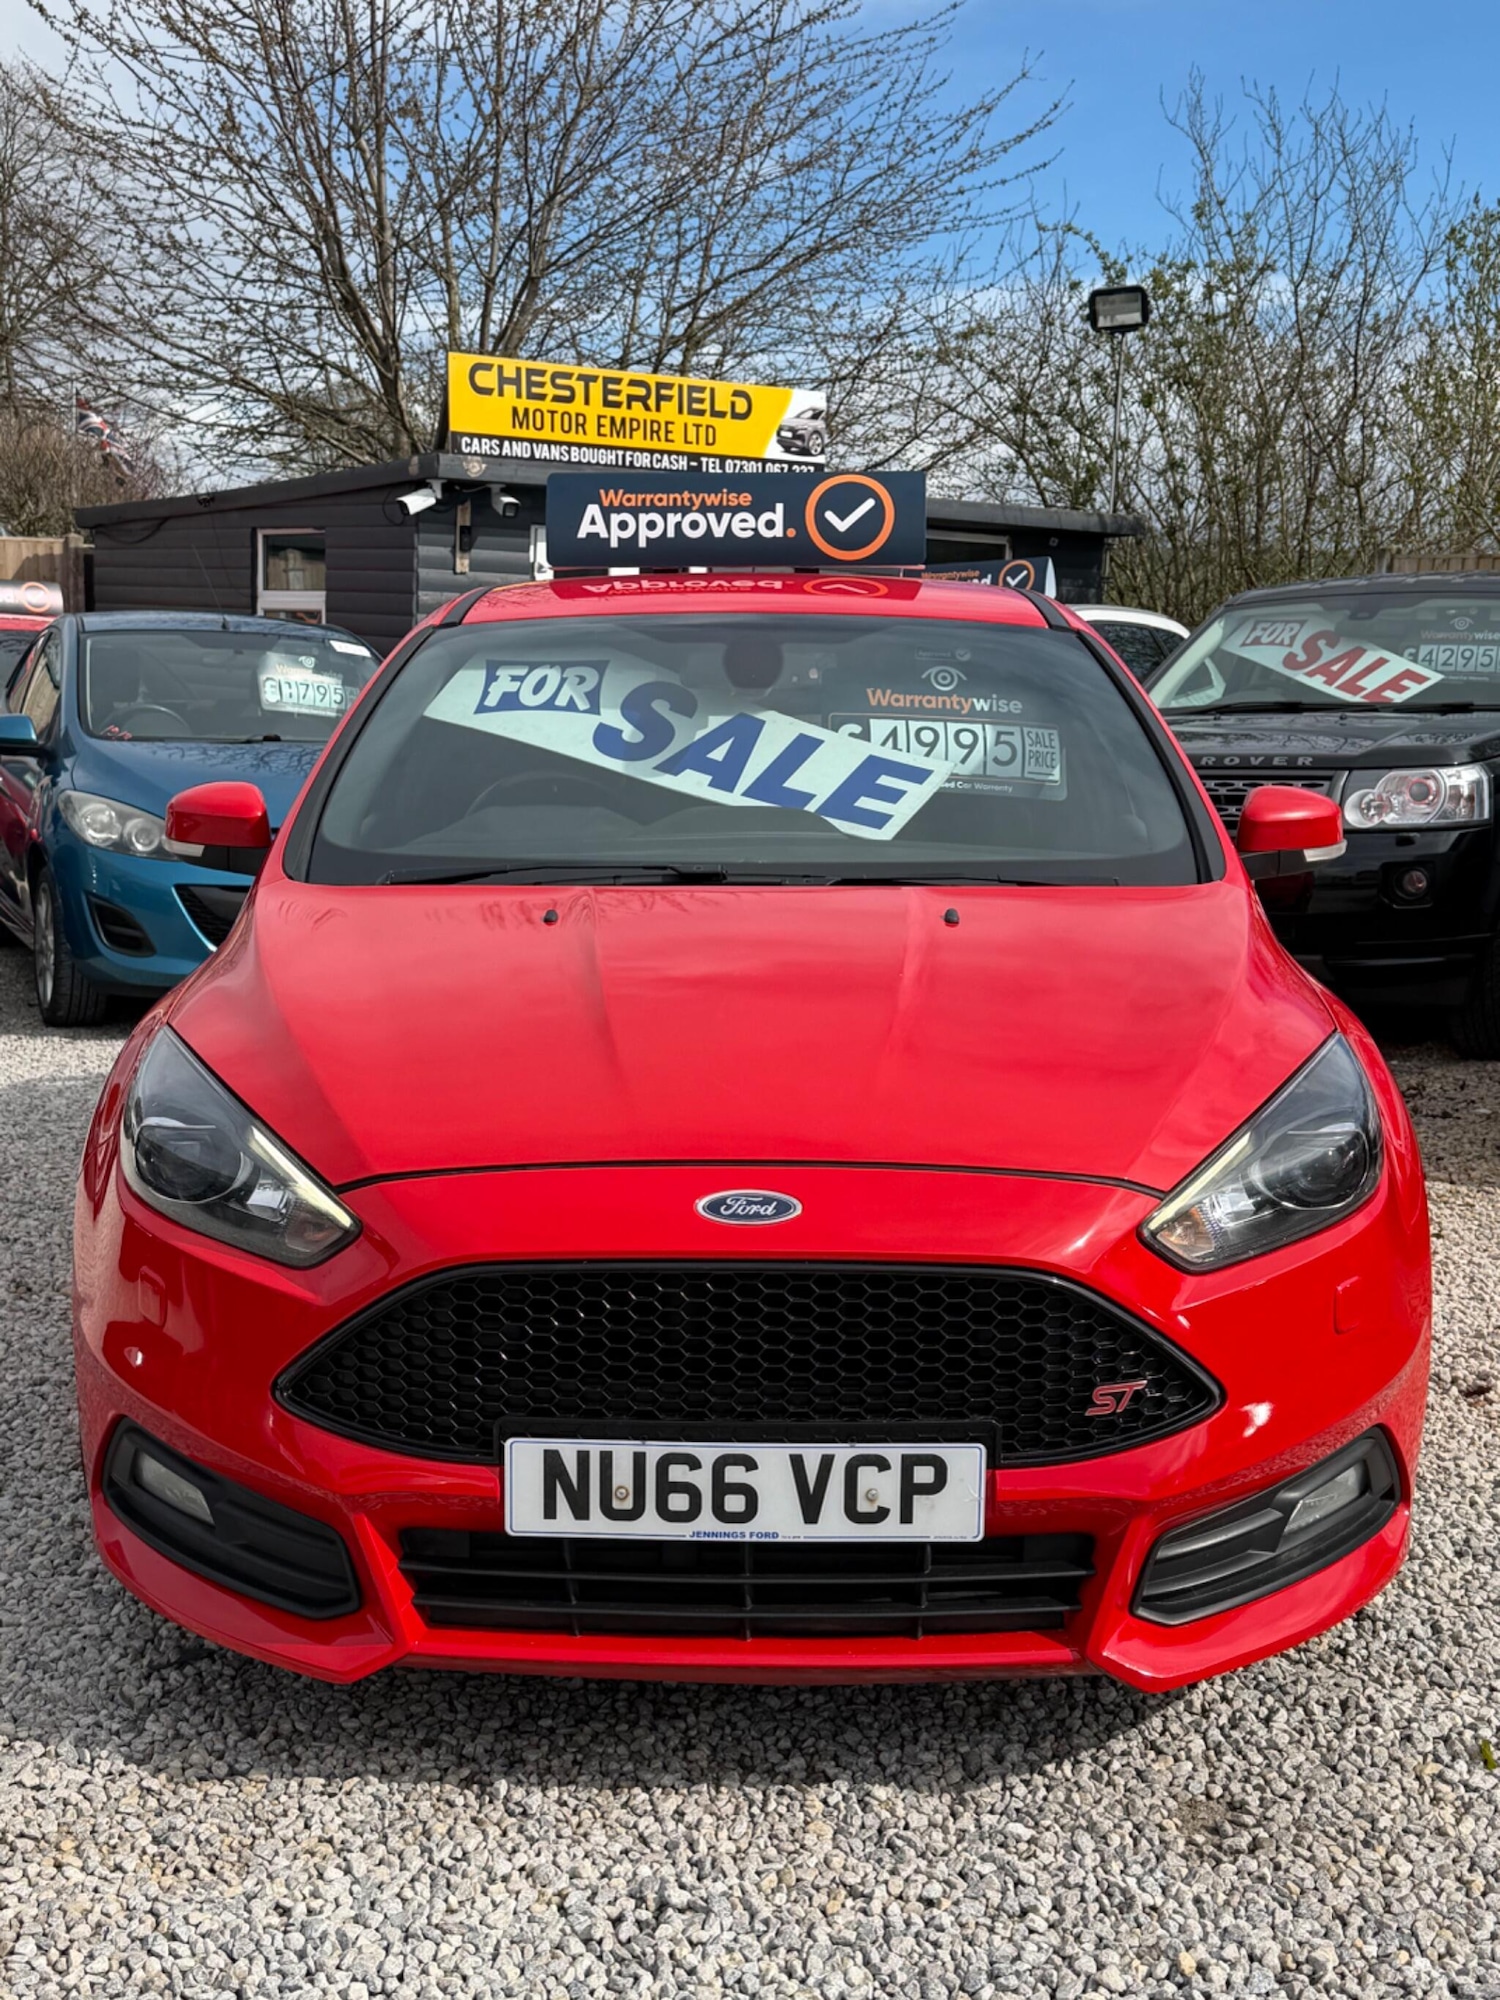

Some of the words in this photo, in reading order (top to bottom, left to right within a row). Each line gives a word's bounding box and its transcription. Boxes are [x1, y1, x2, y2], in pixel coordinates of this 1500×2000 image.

[468, 362, 753, 420] CHESTERFIELD
[511, 406, 588, 436] MOTOR
[596, 414, 676, 443] EMPIRE
[683, 422, 717, 446] LTD
[461, 437, 500, 455] CARS
[501, 441, 531, 459] AND
[532, 444, 569, 462] VANS
[570, 447, 625, 467] BOUGHT
[625, 452, 653, 469] FOR
[652, 453, 687, 471] CASH
[700, 457, 723, 473] TEL
[725, 459, 763, 473] 07301
[599, 488, 752, 511] Warrantywise
[576, 502, 797, 548] Approved.
[1246, 621, 1299, 646] FOR
[1282, 630, 1431, 703] SALE
[486, 663, 600, 712] FOR
[866, 689, 1023, 714] Warrantywise
[593, 680, 935, 831] SALE
[1026, 730, 1056, 750] SALE
[1026, 749, 1057, 769] PRICE
[1199, 756, 1313, 766] ROVER
[720, 1196, 778, 1216] Ford
[1084, 1380, 1148, 1416] ST
[542, 1449, 760, 1525] NU66
[788, 1453, 949, 1526] VCP
[689, 1531, 746, 1540] JENNINGS
[749, 1531, 779, 1540] FORD
